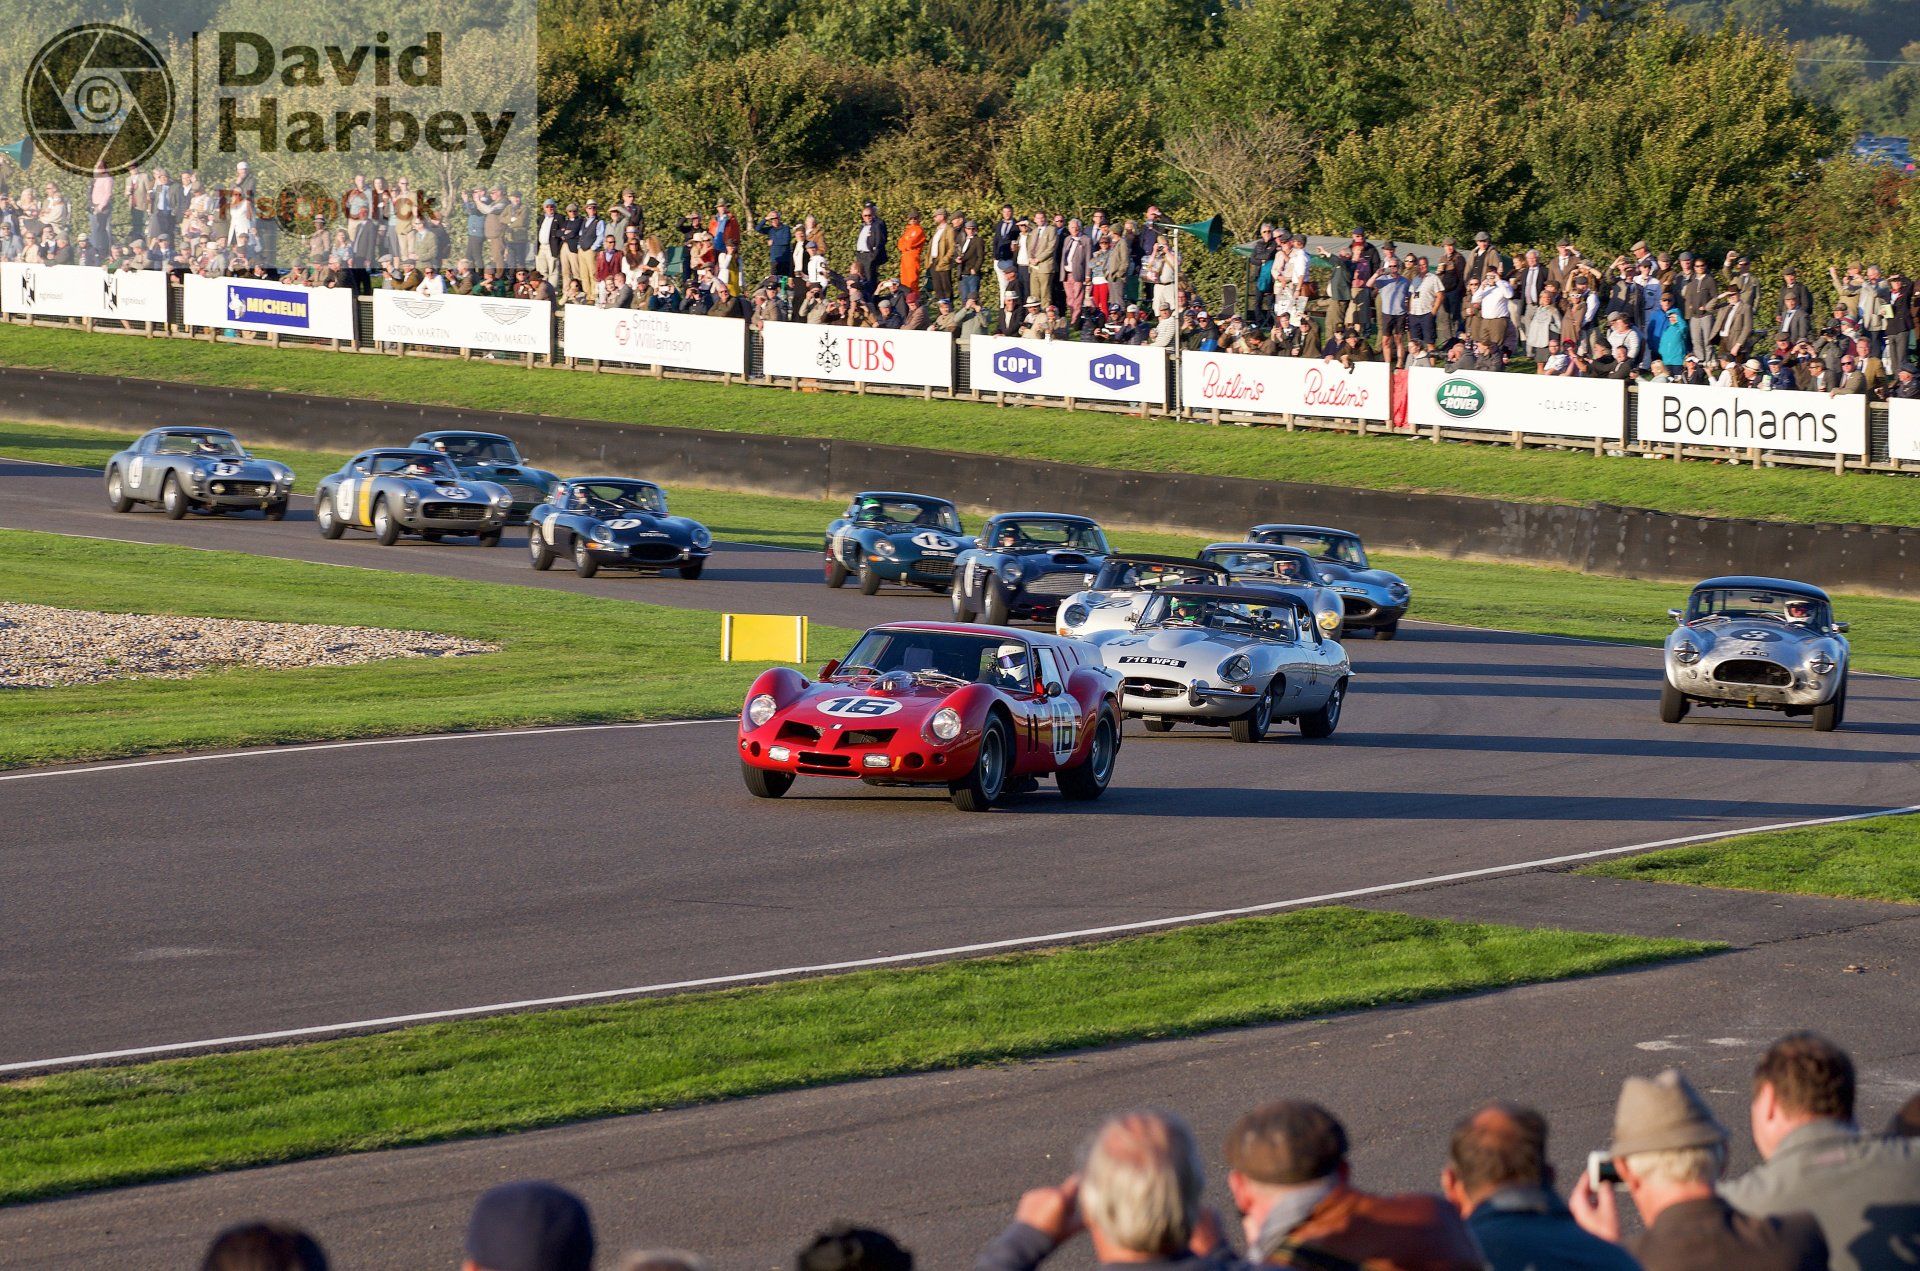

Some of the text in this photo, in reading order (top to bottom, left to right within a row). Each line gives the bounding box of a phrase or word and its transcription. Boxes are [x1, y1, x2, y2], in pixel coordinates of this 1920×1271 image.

[247, 298, 307, 318] MICHELIN
[387, 324, 450, 339] ASTON MARTIN
[632, 313, 663, 332] Smith
[474, 331, 537, 346] ASTON MARTIN
[633, 332, 691, 353] Williamson
[847, 338, 895, 372] UBS
[997, 356, 1037, 375] COPL
[1094, 363, 1135, 381] COPL
[1202, 361, 1264, 401] Butlin's
[1304, 367, 1369, 408] Butlin's
[1443, 385, 1472, 398] LAND
[1445, 397, 1479, 411] ROVER
[1662, 396, 1838, 443] Bonhams
[610, 520, 632, 530] 17
[1126, 656, 1148, 664] 716
[827, 698, 897, 715] 16
[1053, 702, 1073, 755] 16
